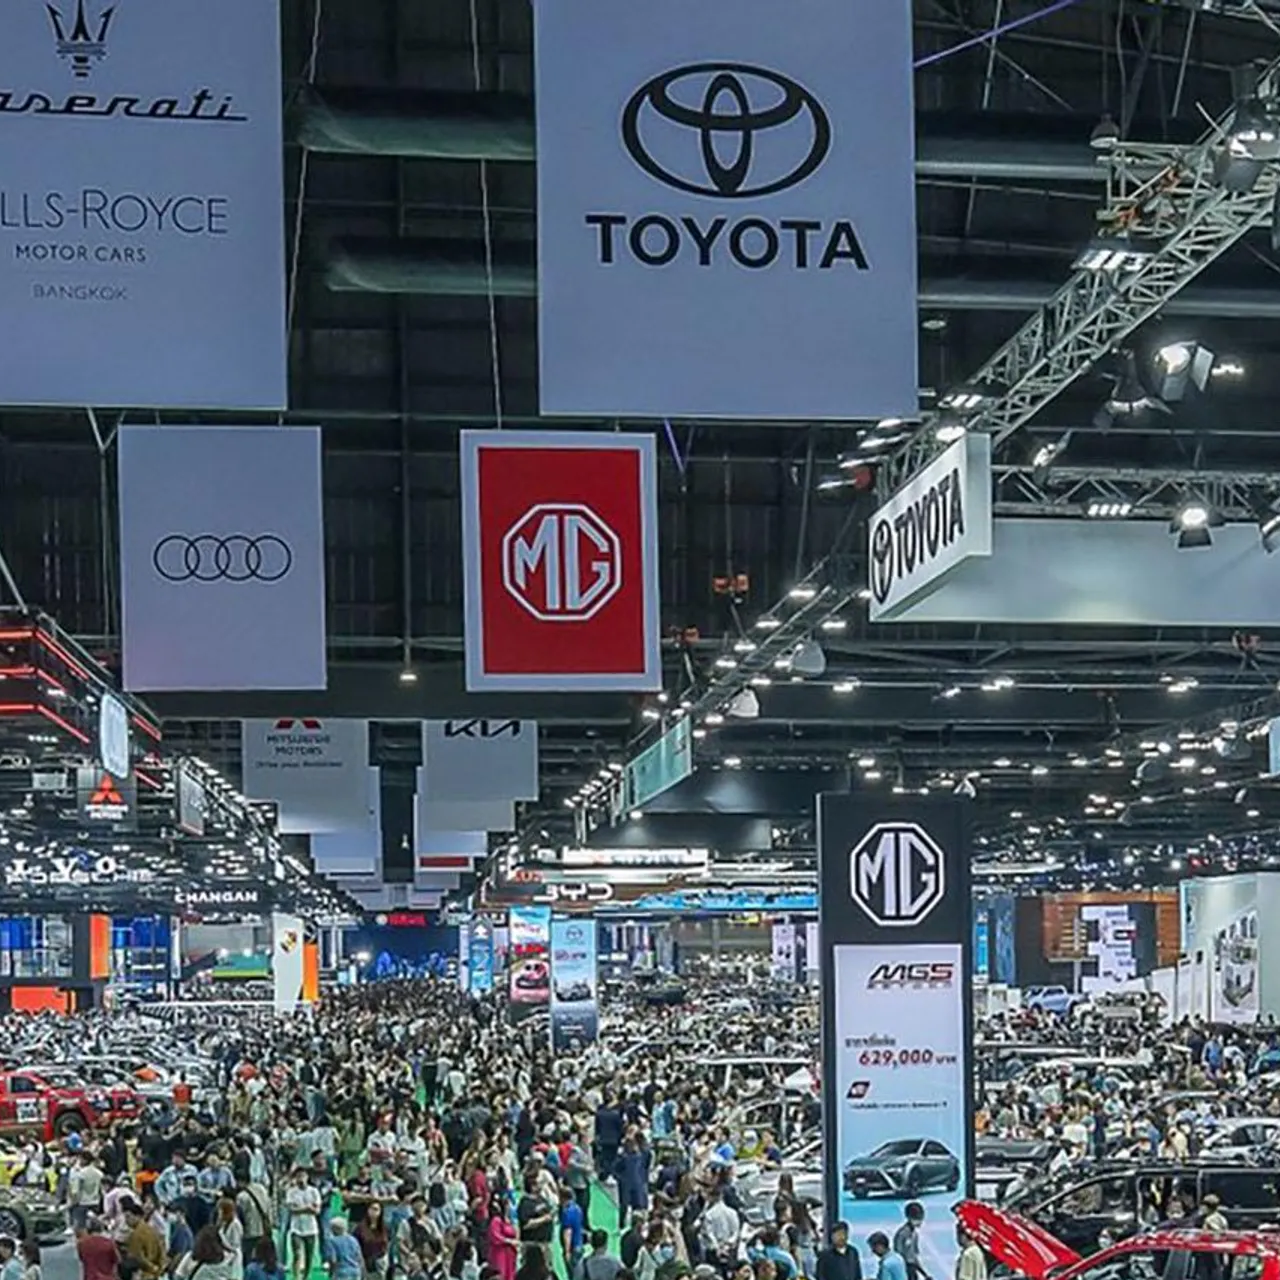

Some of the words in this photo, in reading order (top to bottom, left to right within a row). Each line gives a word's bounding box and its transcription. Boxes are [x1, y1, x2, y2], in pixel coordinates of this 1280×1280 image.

[15, 244, 88, 261] MOTOR
[95, 245, 148, 262] CARS
[585, 213, 870, 271] TOYOTA
[33, 284, 128, 301] BANGKOK
[894, 467, 965, 580] TOYOTA
[513, 514, 611, 611] MG
[856, 831, 938, 918] MG
[174, 891, 259, 903] CHANGAN
[858, 1049, 933, 1068] 629,000
